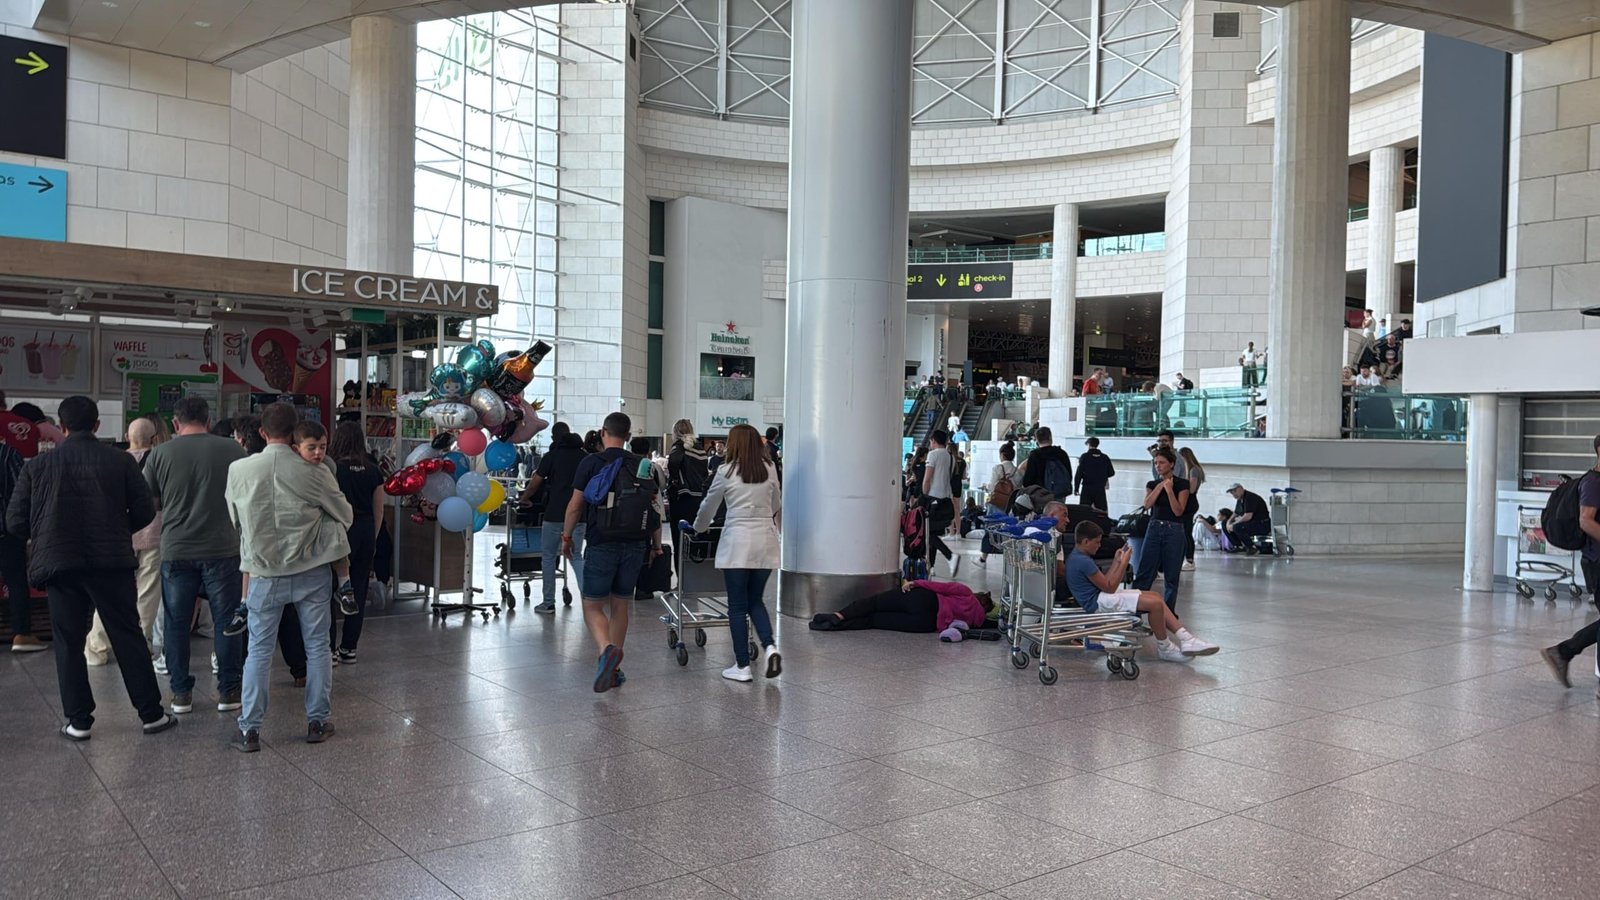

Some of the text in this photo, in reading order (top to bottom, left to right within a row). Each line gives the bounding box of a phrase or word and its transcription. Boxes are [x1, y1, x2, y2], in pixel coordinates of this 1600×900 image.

[974, 273, 1006, 282] check-in
[293, 268, 493, 310] ICE CREAM &
[710, 333, 750, 345] Heineken
[113, 341, 147, 353] WAFFLE
[132, 359, 159, 369] JOGOS
[711, 416, 724, 426] My
